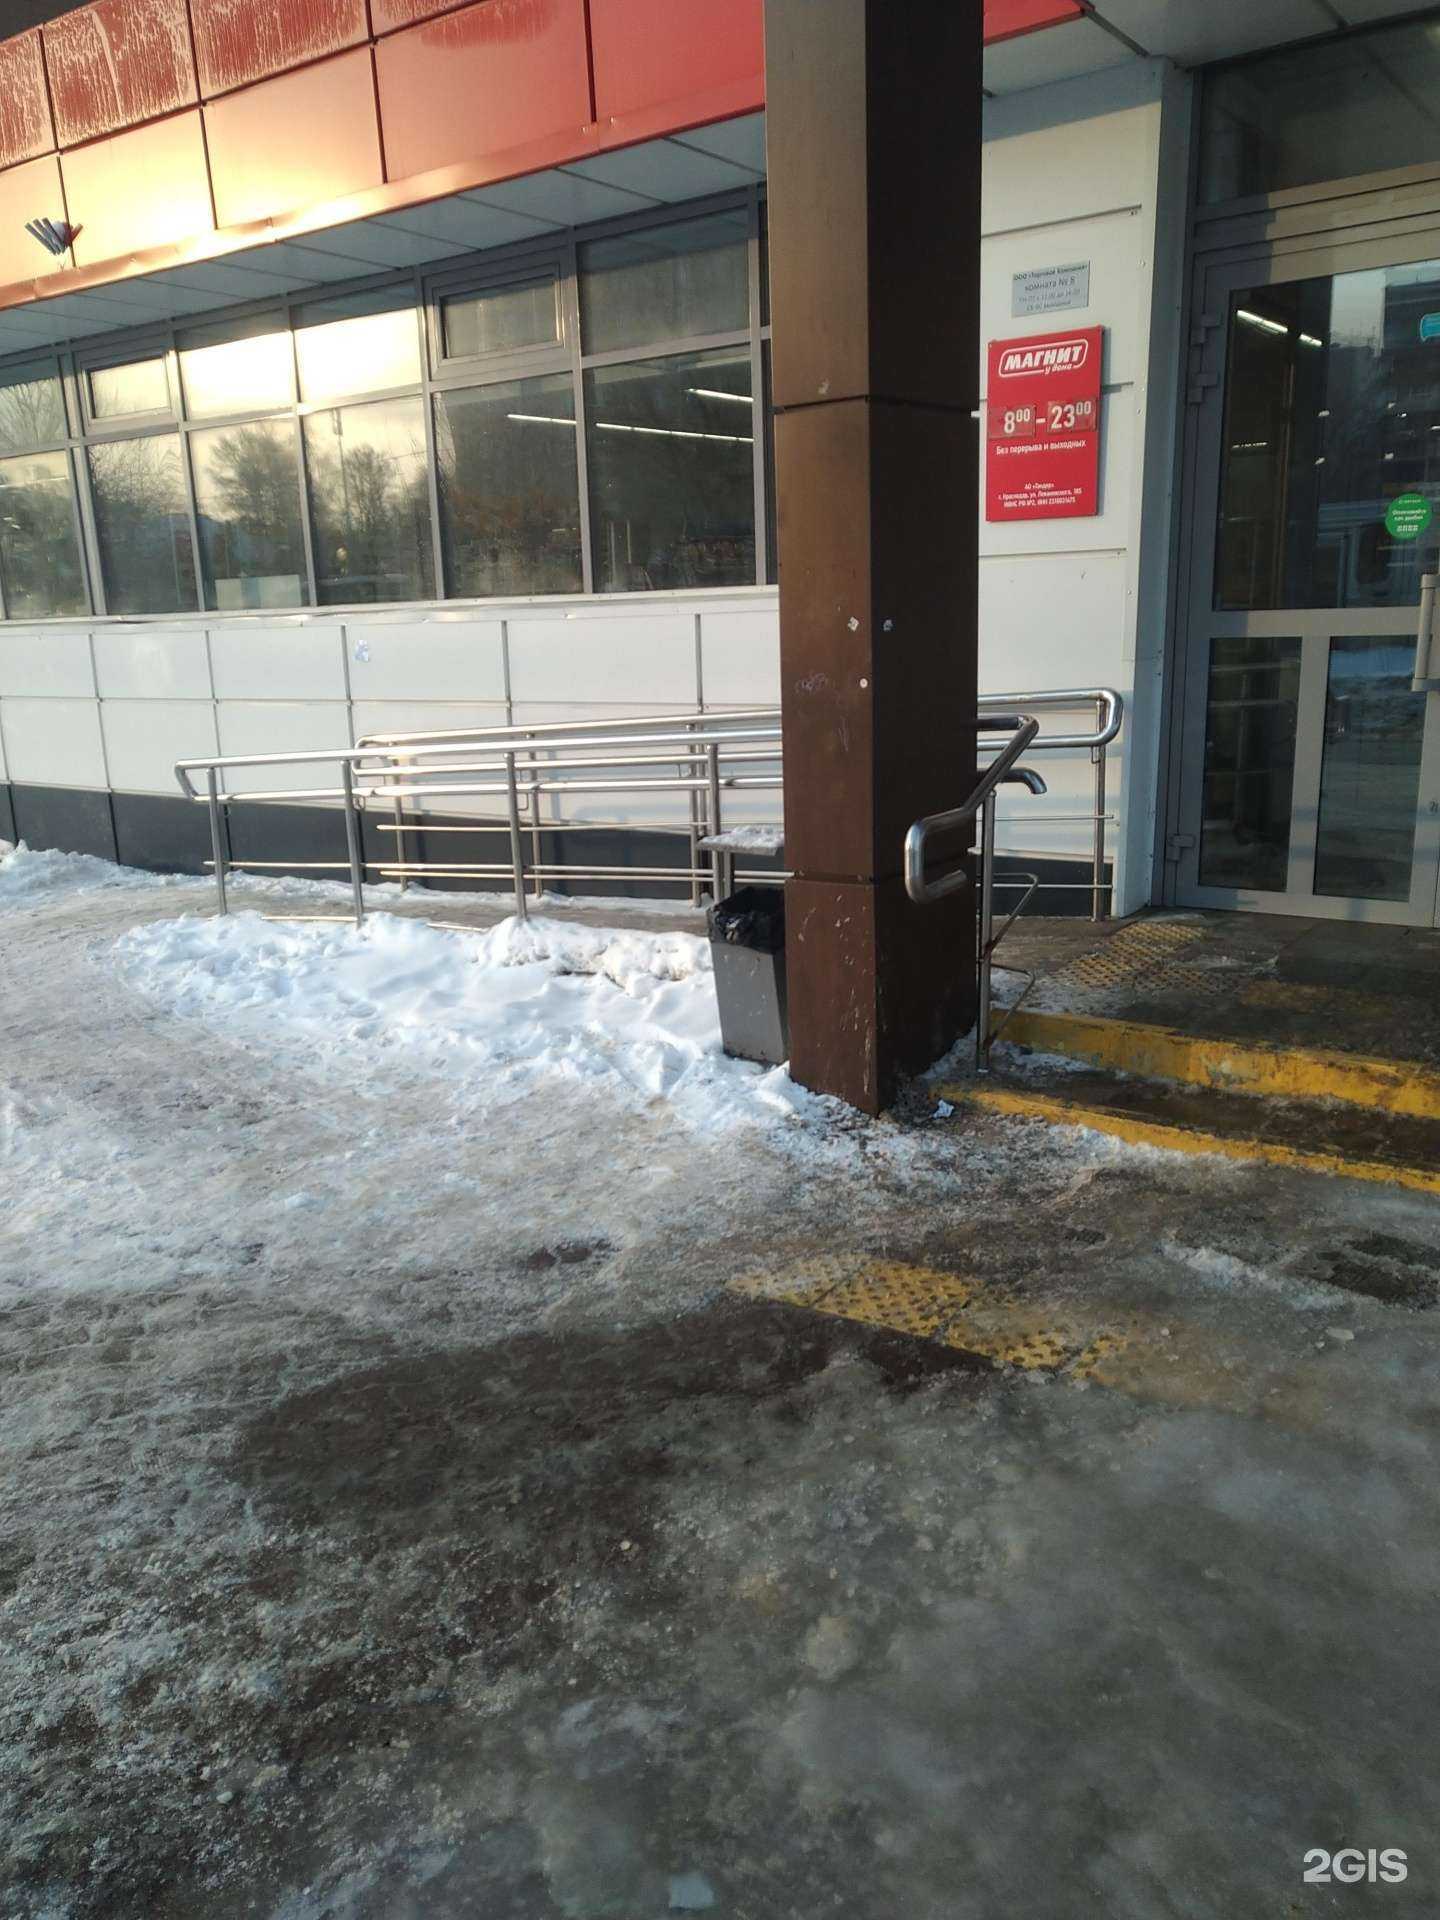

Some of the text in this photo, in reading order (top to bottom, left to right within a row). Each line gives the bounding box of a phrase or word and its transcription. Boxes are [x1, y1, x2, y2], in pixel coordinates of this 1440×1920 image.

[1004, 345, 1082, 371] МАГНИТ
[1045, 362, 1073, 375] у дома
[996, 440, 1087, 456] Без перерыва и выходных
